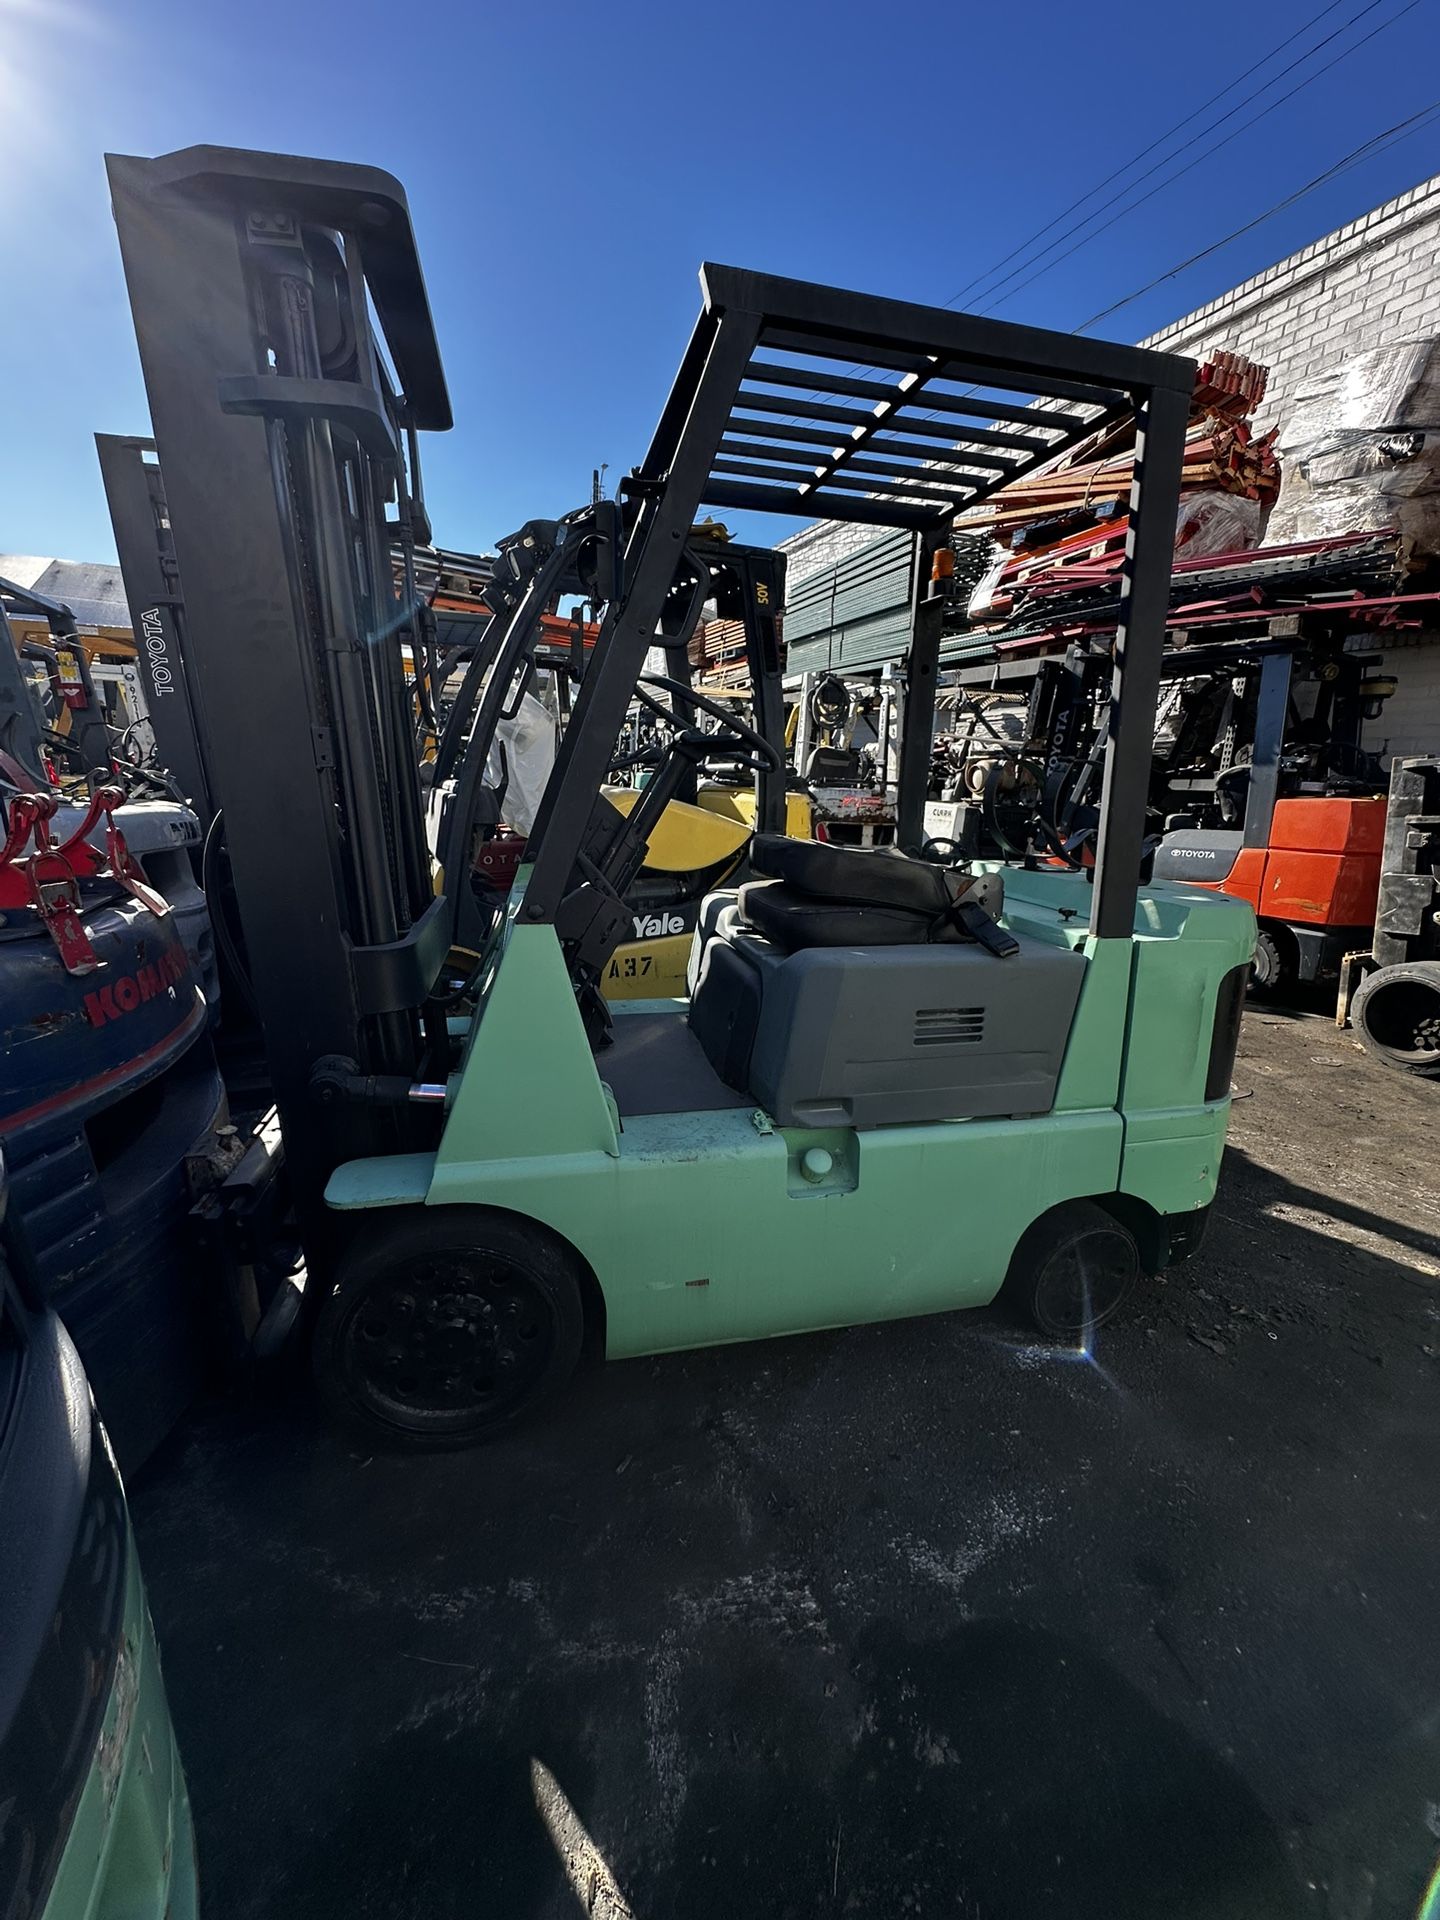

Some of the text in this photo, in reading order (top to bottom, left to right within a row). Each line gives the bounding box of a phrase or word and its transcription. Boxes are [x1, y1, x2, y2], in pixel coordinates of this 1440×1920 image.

[756, 581, 769, 605] 50V
[141, 607, 175, 697] TOYOTA
[1046, 709, 1070, 777] TOYOTA
[1181, 849, 1215, 859] TOYOTA
[632, 912, 685, 938] Yale
